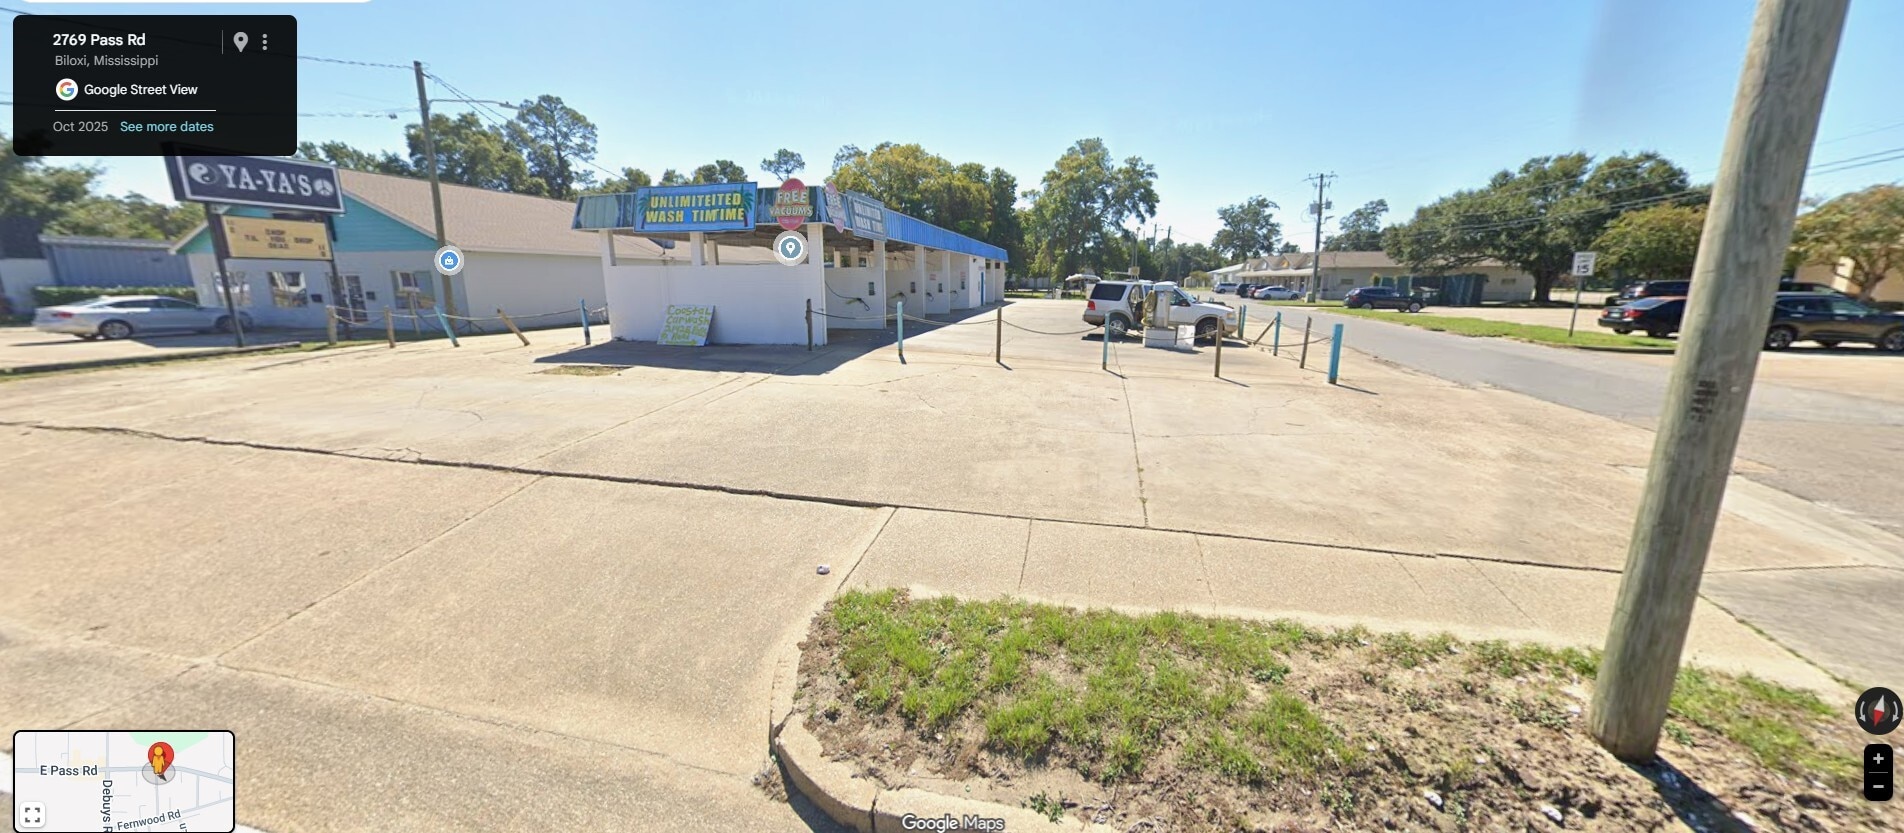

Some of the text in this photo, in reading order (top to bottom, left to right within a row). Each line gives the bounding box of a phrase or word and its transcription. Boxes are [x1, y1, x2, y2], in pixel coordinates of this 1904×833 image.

[218, 164, 312, 197] YA-YA'S
[650, 192, 742, 209] UNLIMITEITED
[776, 190, 807, 204] FREE
[645, 210, 684, 223] WASH
[768, 205, 814, 217] VACUUMS
[1576, 264, 1589, 273] 15
